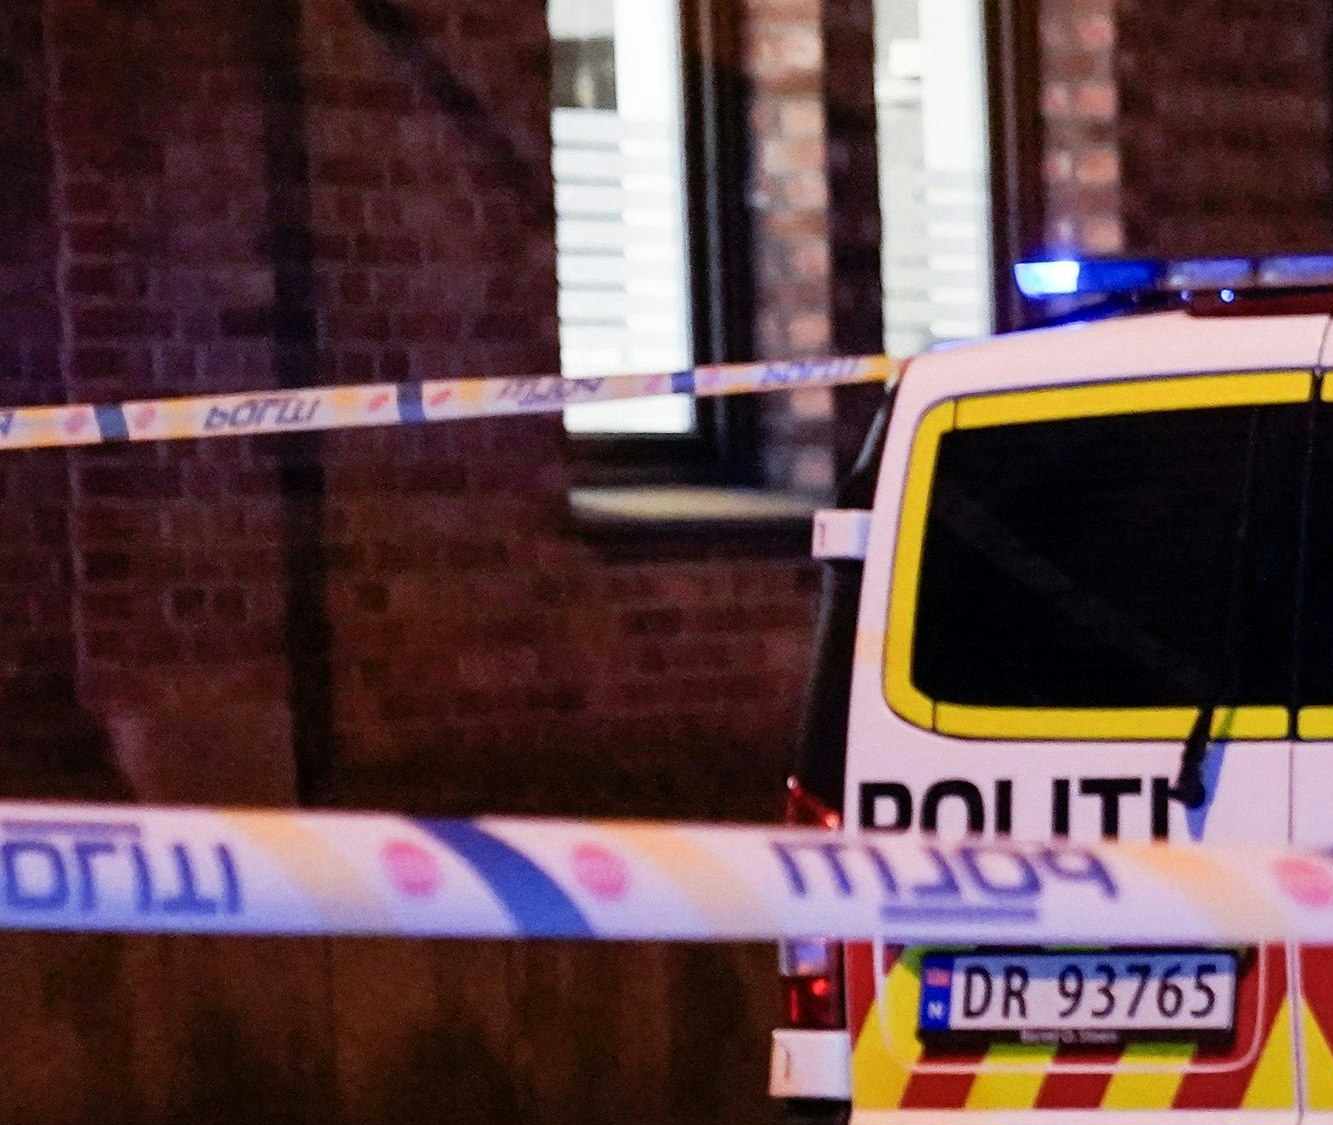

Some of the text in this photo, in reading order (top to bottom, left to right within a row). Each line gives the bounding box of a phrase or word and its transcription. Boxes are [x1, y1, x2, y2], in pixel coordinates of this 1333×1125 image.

[927, 1001, 944, 1019] N
[962, 962, 1219, 1021] DR 93765
